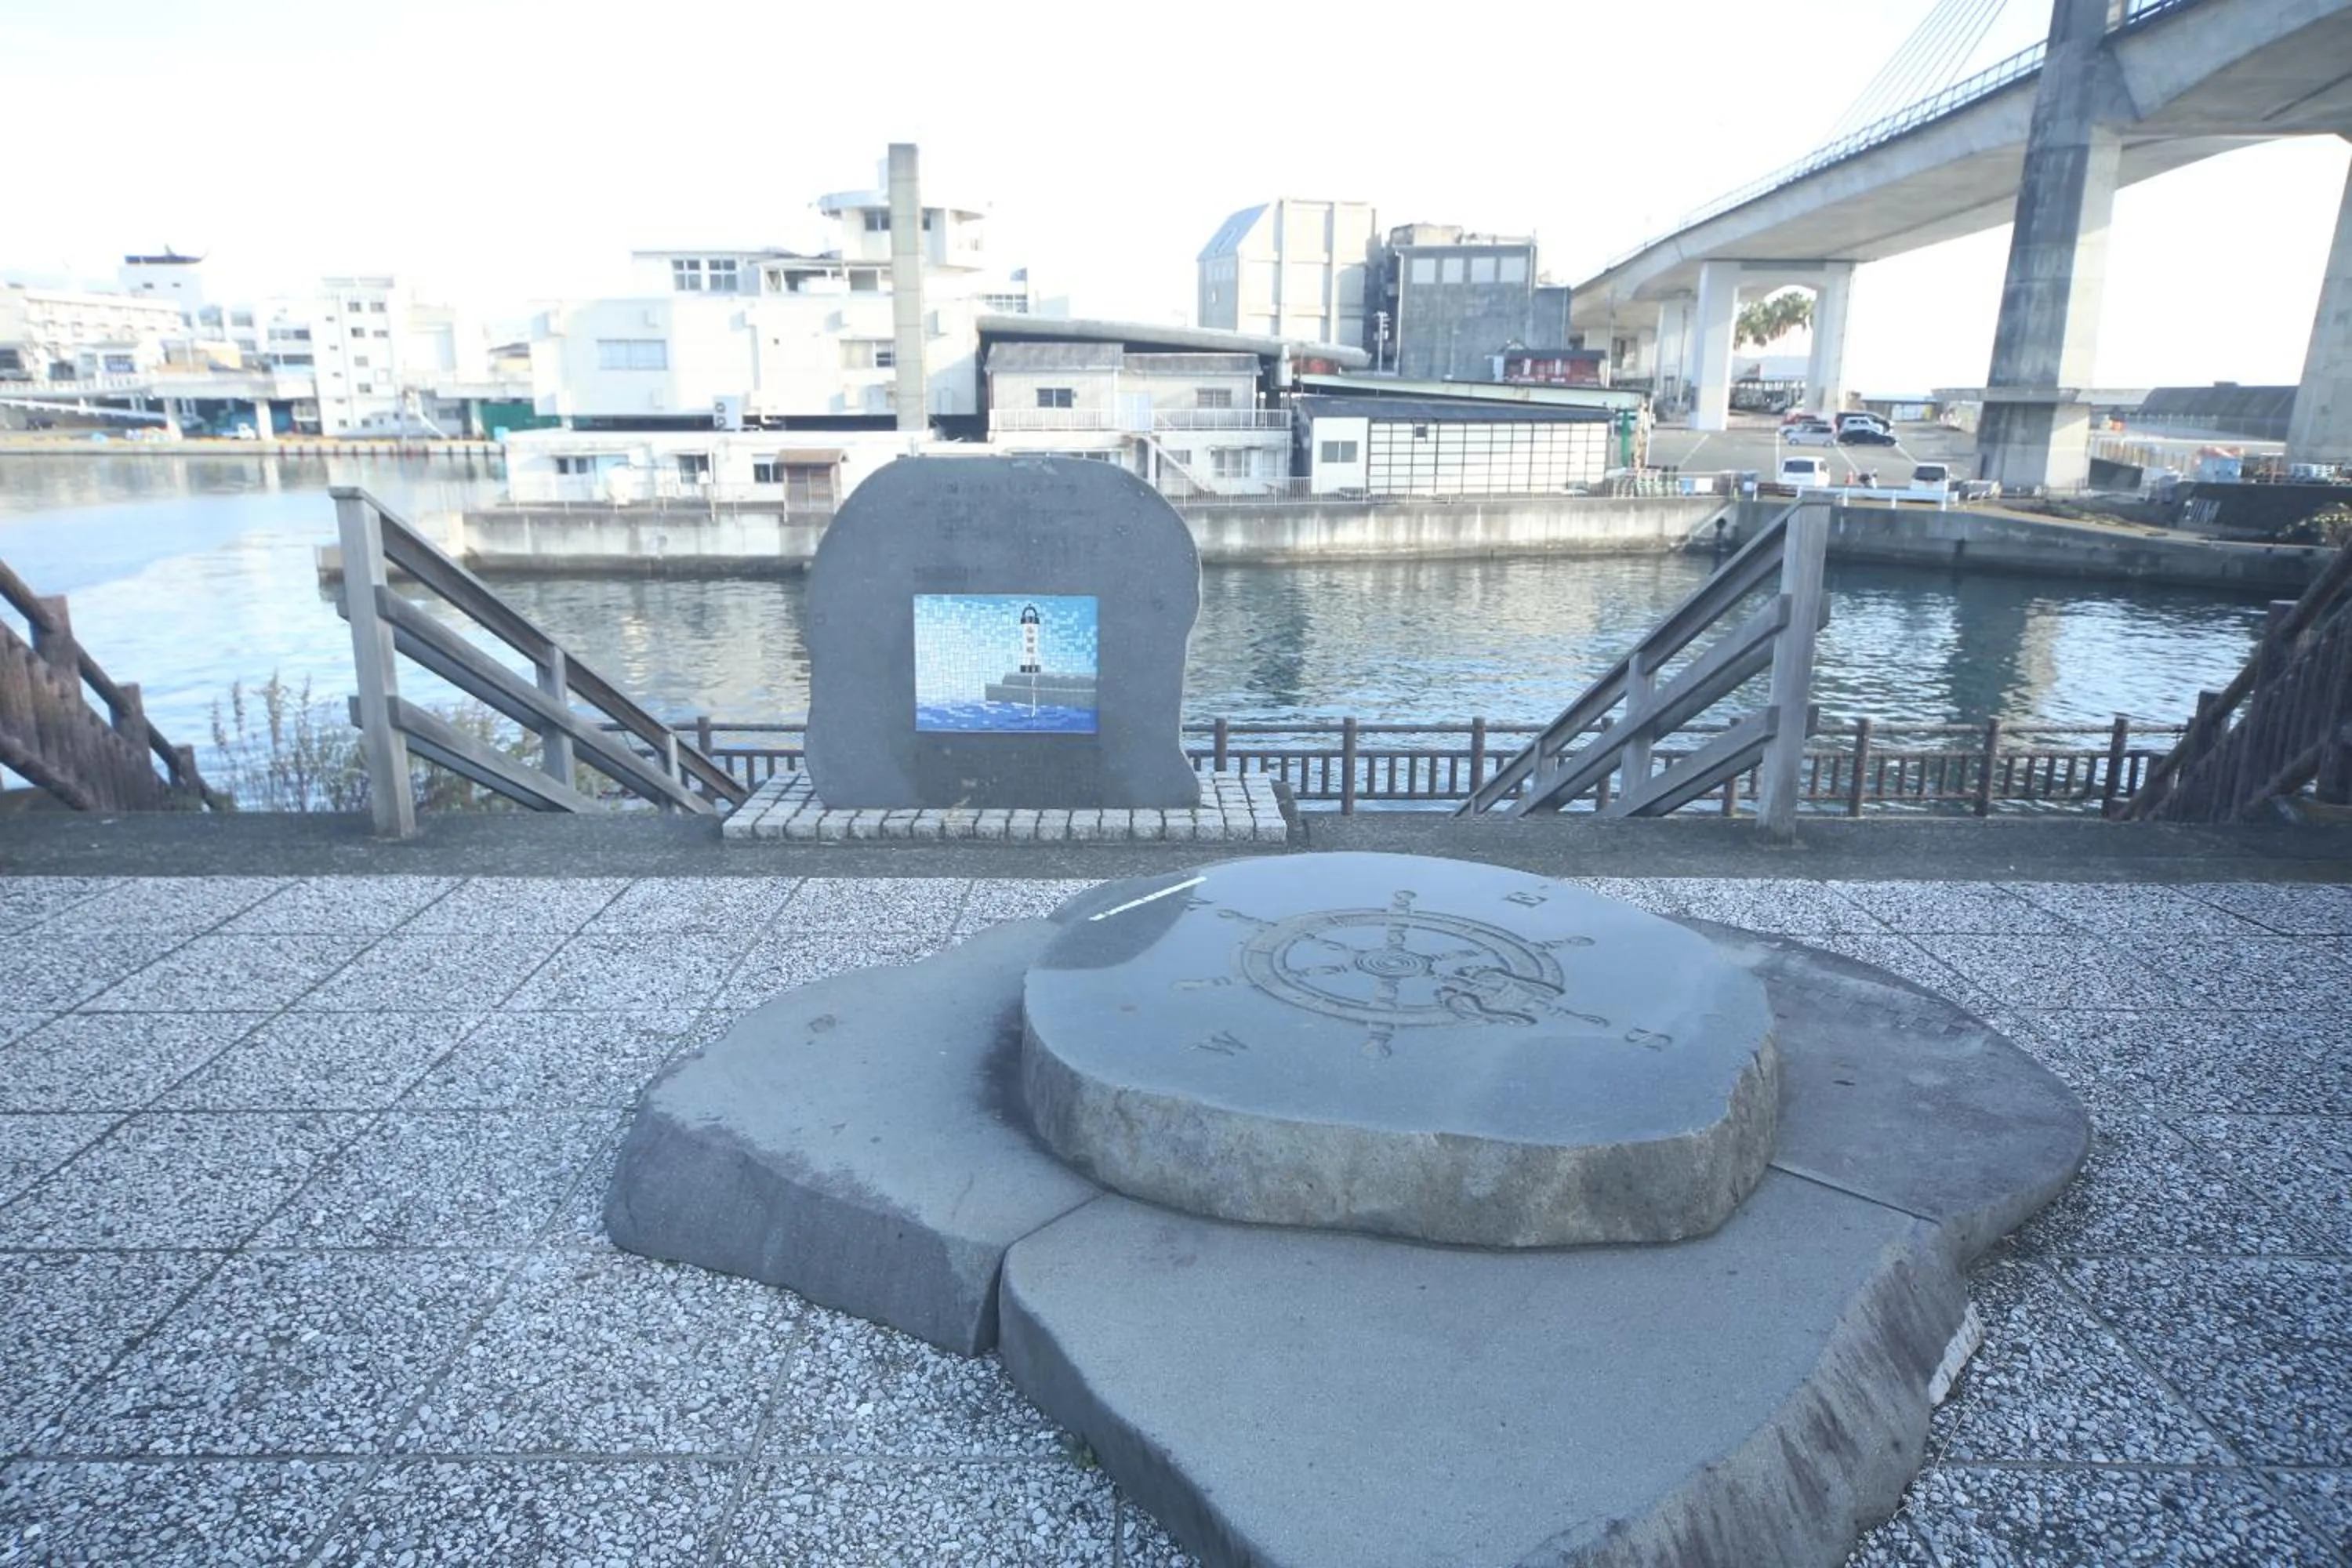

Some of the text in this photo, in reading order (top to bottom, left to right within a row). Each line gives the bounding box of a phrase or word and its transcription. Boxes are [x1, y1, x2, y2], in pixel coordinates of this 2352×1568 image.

[1502, 891, 1548, 908] E
[1196, 1030, 1249, 1057] W
[1624, 1025, 1673, 1052] S
